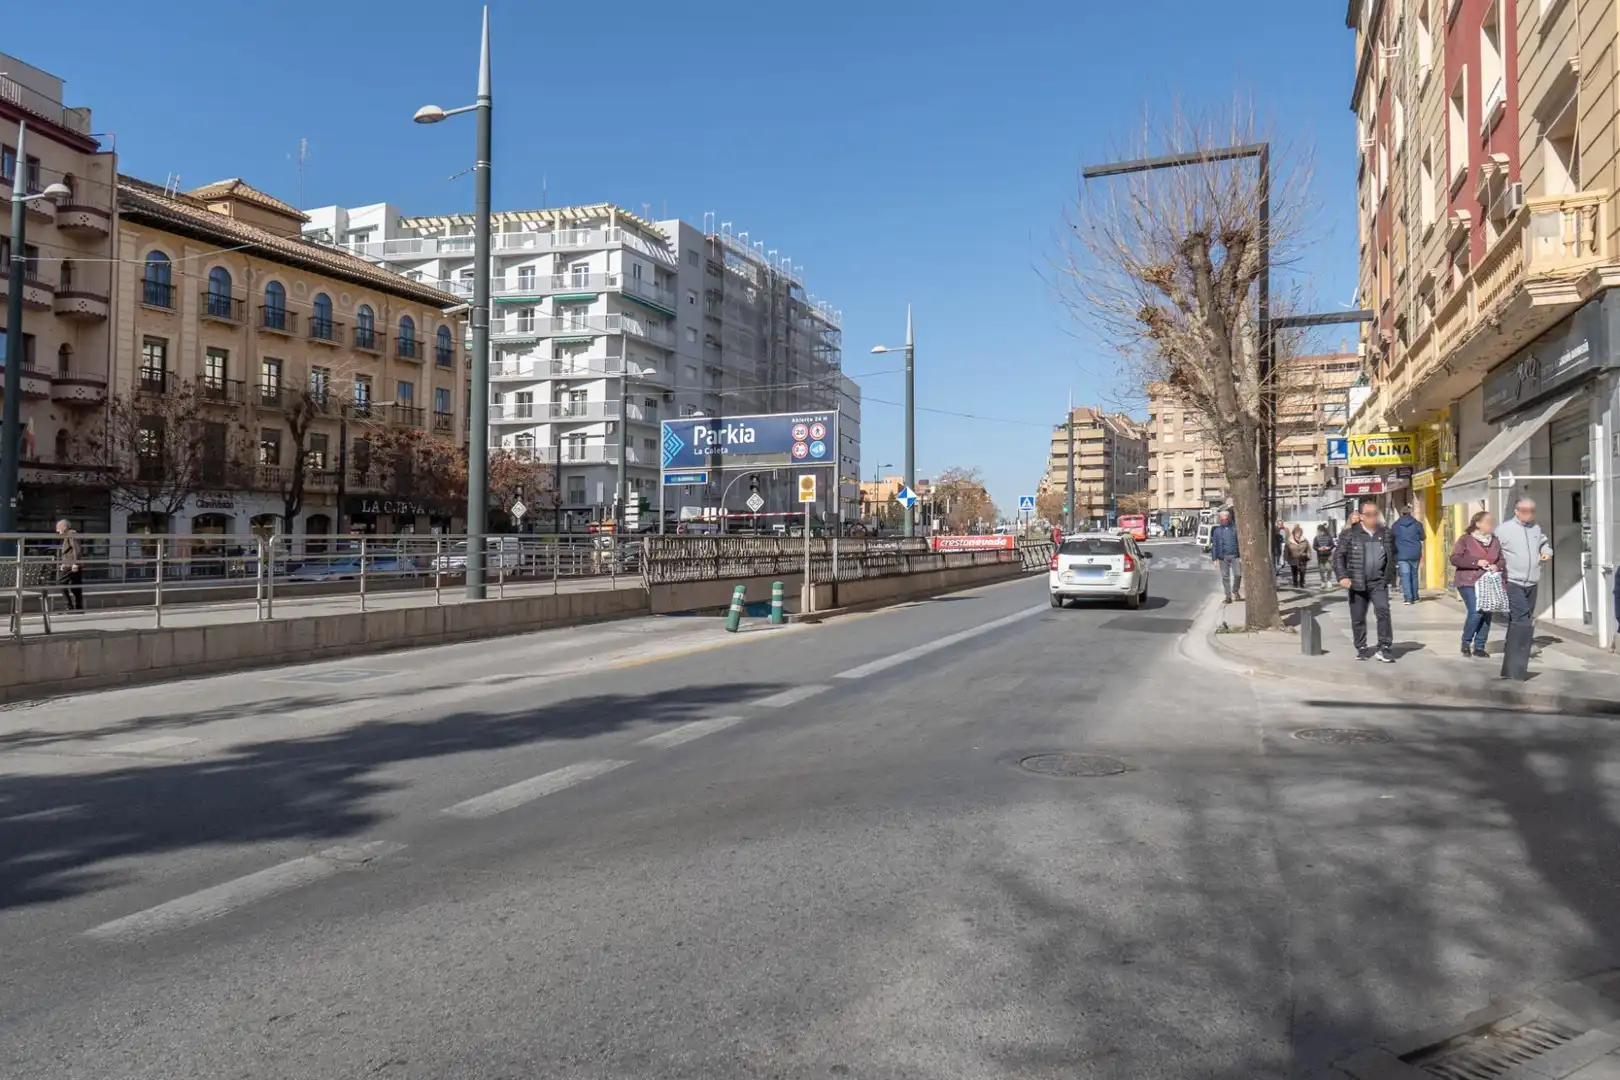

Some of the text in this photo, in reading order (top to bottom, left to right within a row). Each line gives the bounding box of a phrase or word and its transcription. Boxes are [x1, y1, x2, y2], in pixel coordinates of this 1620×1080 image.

[693, 423, 756, 446] Parkia
[704, 447, 729, 455] Caleta
[1330, 440, 1346, 459] L
[1350, 439, 1411, 457] MOLINA
[361, 500, 380, 513] LA
